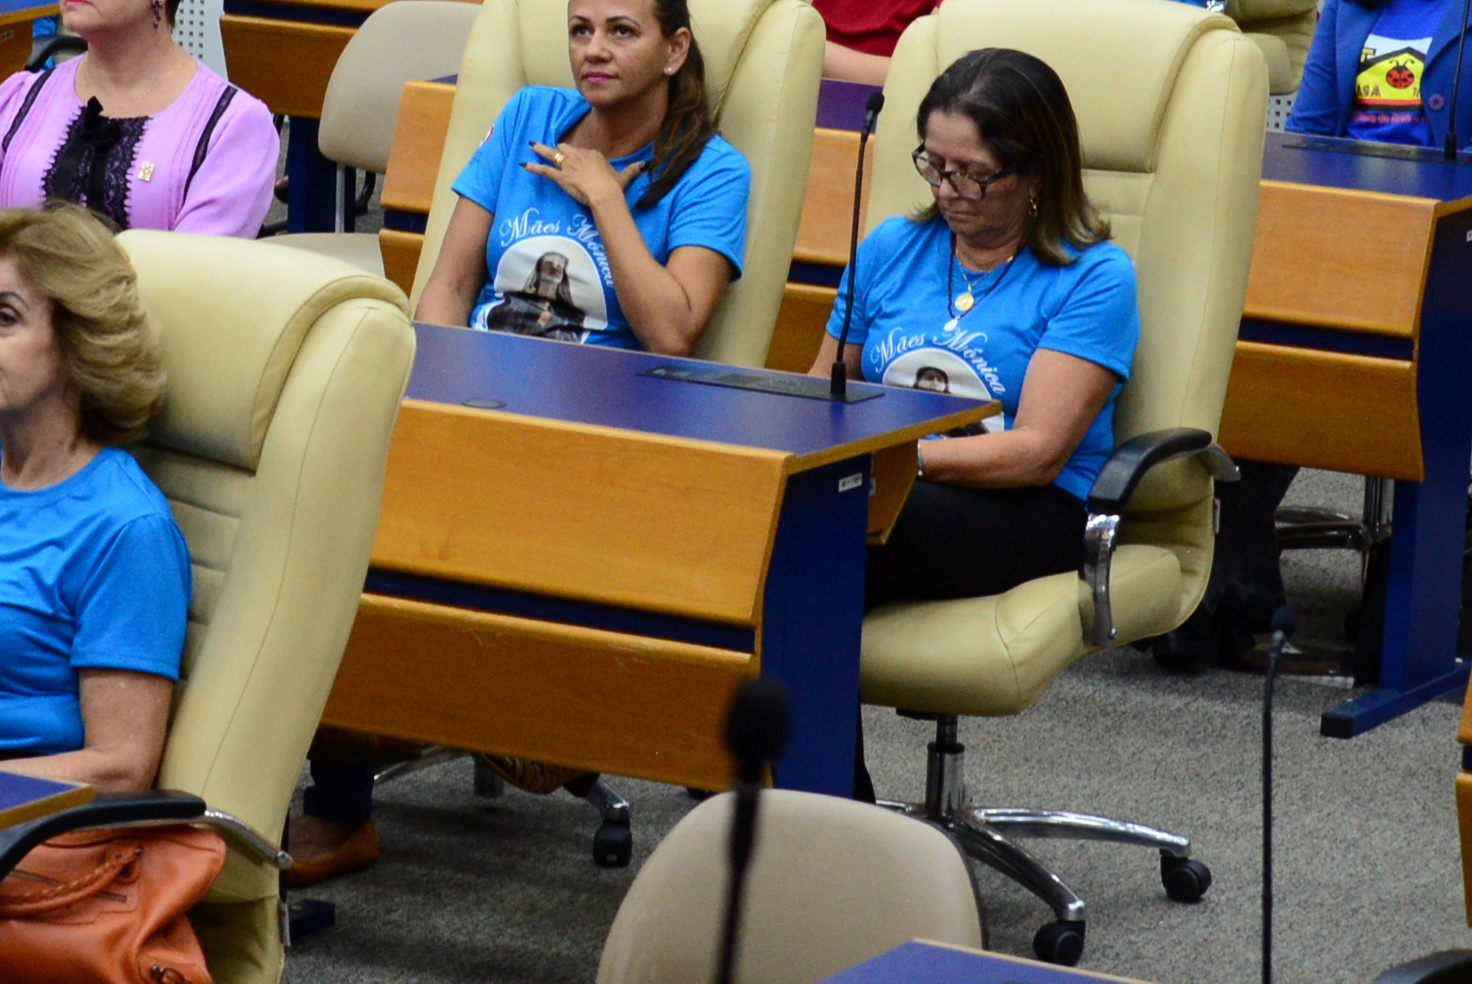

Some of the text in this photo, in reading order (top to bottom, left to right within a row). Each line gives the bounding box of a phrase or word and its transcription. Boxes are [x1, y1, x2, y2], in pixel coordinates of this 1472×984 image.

[499, 207, 562, 248] Mães
[870, 326, 1006, 395] Mães Mônica
